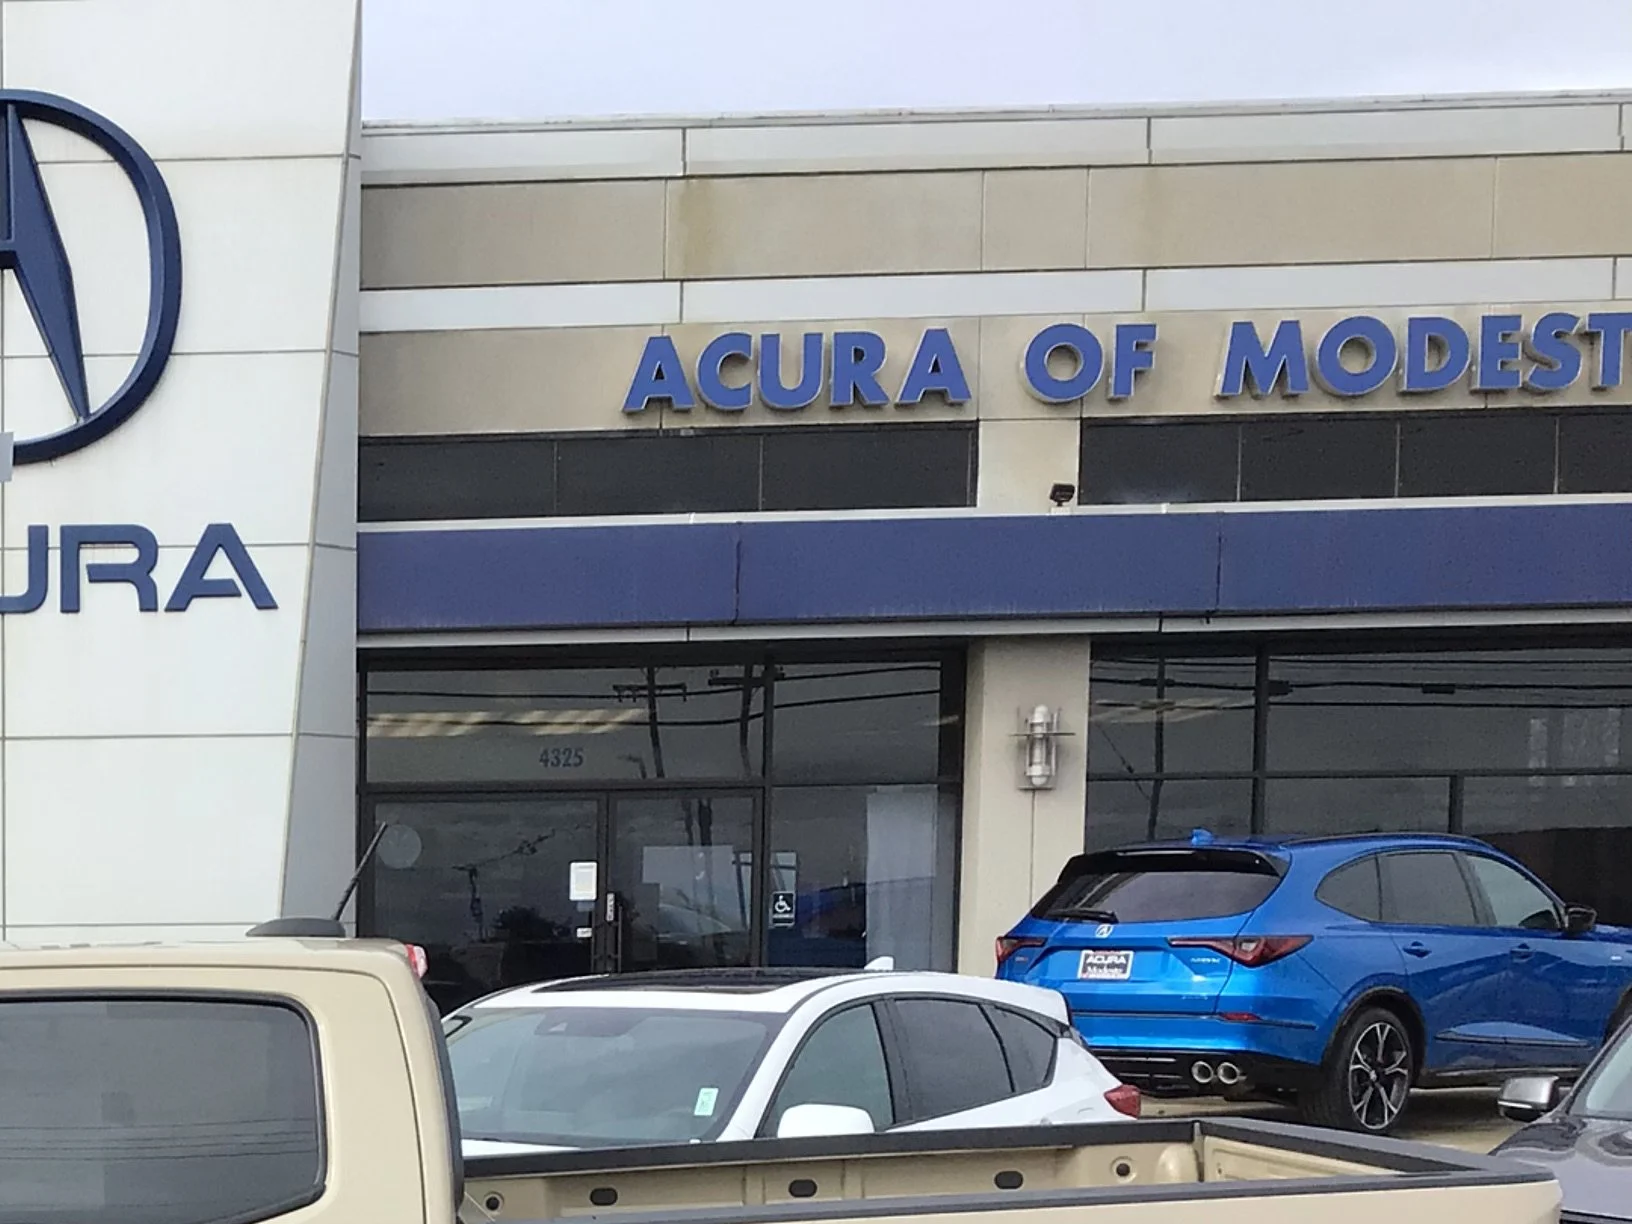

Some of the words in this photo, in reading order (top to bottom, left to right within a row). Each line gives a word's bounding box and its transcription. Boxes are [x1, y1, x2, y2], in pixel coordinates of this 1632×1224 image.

[621, 327, 972, 412] ACURA
[1024, 322, 1158, 403] OF
[539, 747, 583, 768] 4325
[1085, 955, 1127, 964] ACURA
